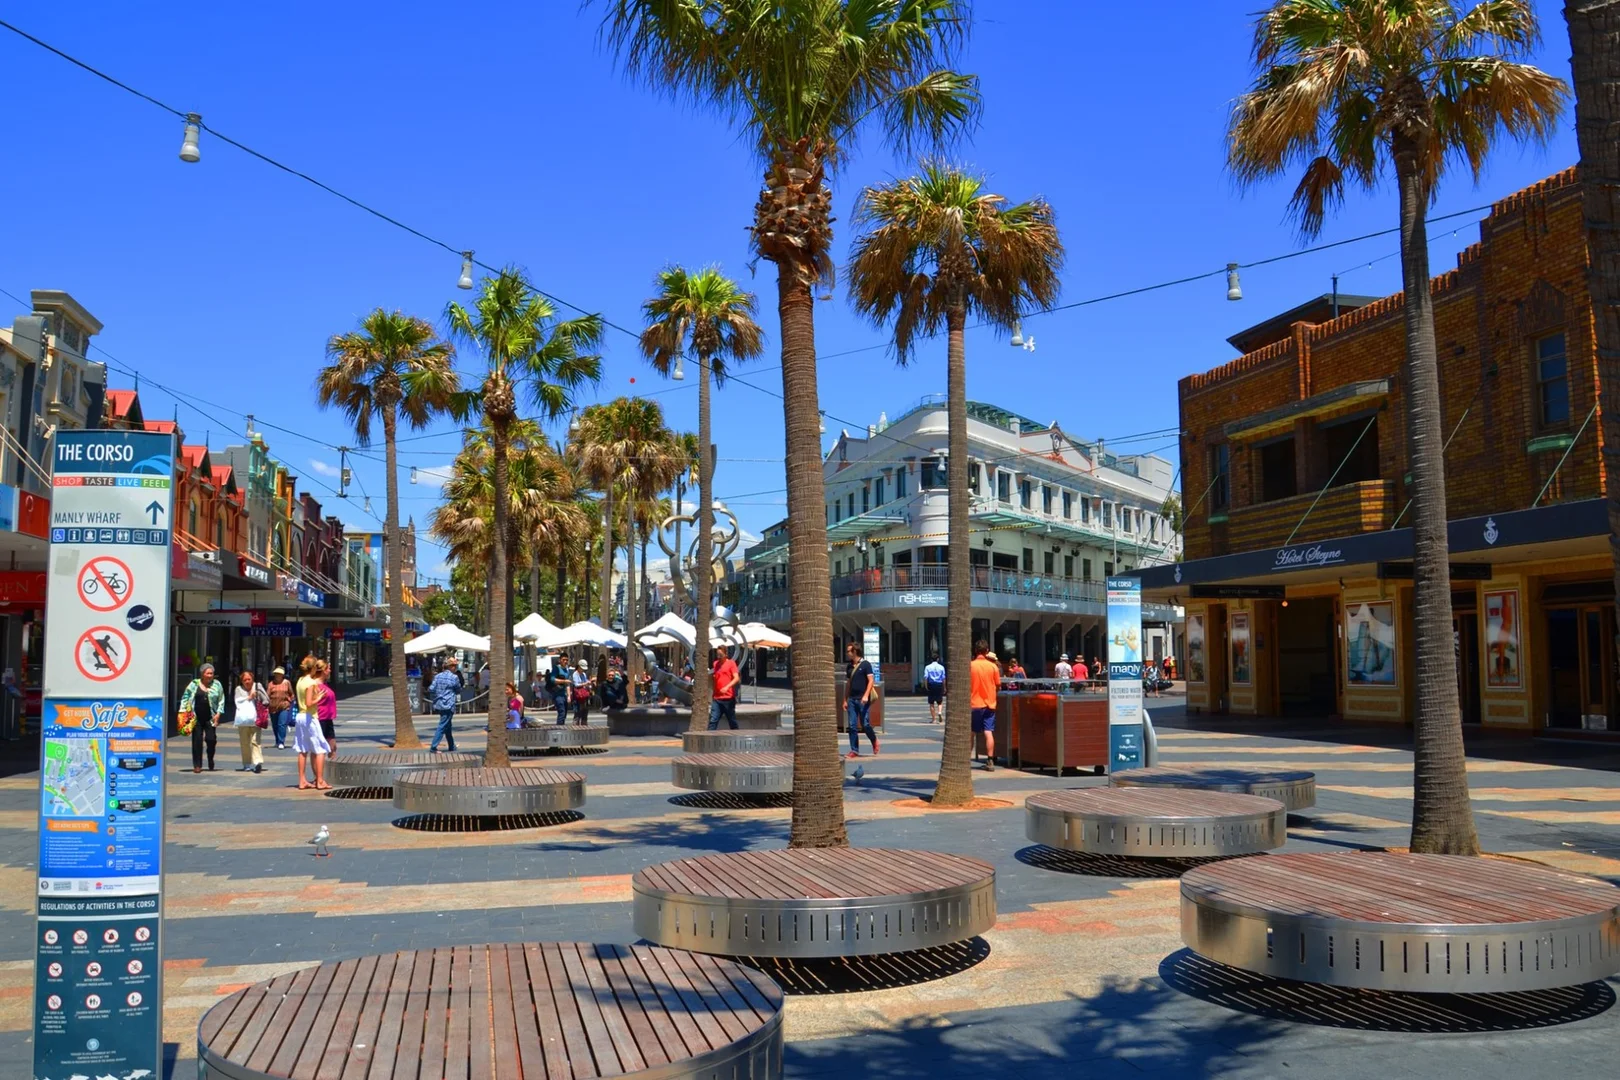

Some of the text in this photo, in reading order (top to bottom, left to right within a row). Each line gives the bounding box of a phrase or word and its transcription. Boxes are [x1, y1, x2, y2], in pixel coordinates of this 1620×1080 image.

[58, 444, 134, 461] THE CORSO
[56, 477, 166, 488] SHOP TASTE LIVE FEEL
[53, 512, 121, 524] MANLY WHARF
[1275, 545, 1342, 566] Hotel Steyne
[1111, 664, 1141, 676] manly
[81, 702, 128, 731] Safe
[40, 902, 76, 910] REGULATIONS
[77, 902, 85, 910] OF
[86, 902, 115, 910] ACTIVITIES
[124, 901, 135, 909] THE
[136, 900, 156, 908] CORSO
